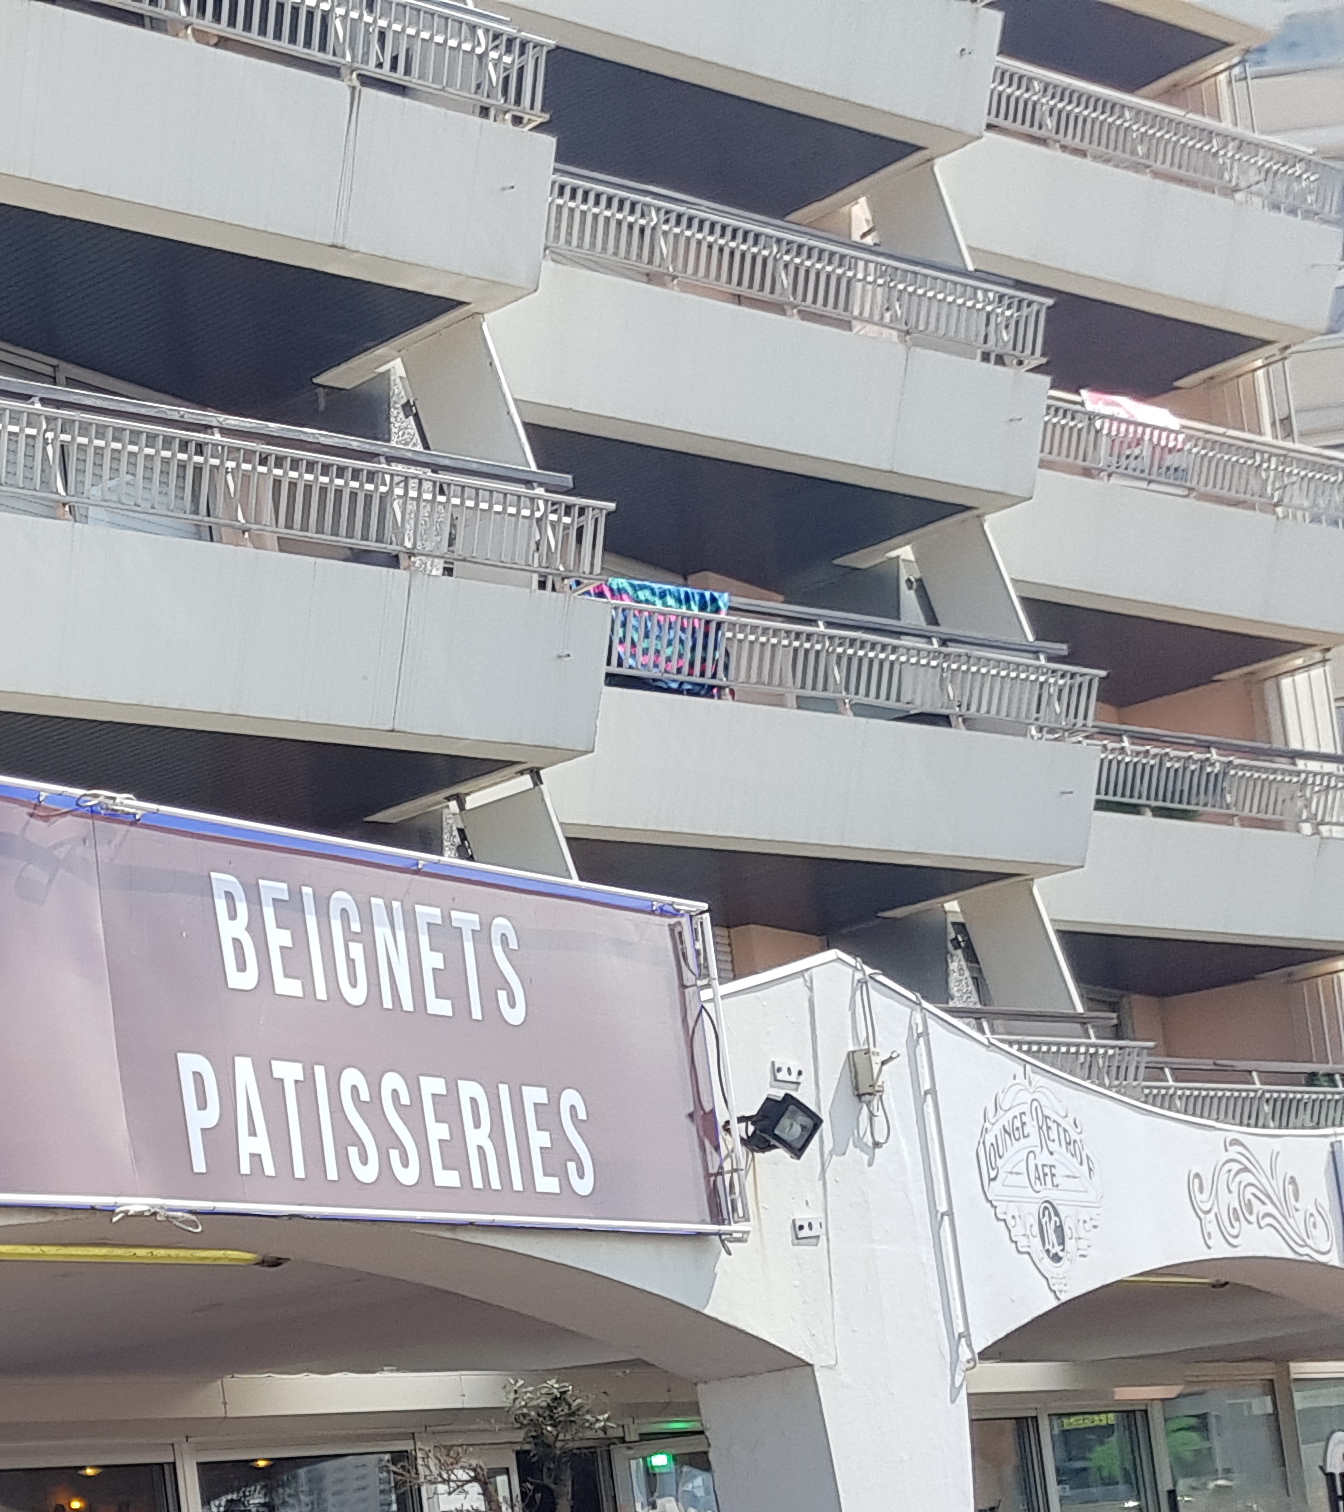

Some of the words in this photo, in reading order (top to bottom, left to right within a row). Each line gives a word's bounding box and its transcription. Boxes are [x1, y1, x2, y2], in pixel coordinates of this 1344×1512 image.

[209, 870, 529, 1026] BEIGNETS
[175, 1050, 596, 1197] PATISSERIES
[983, 1111, 1030, 1183] LOUNGE
